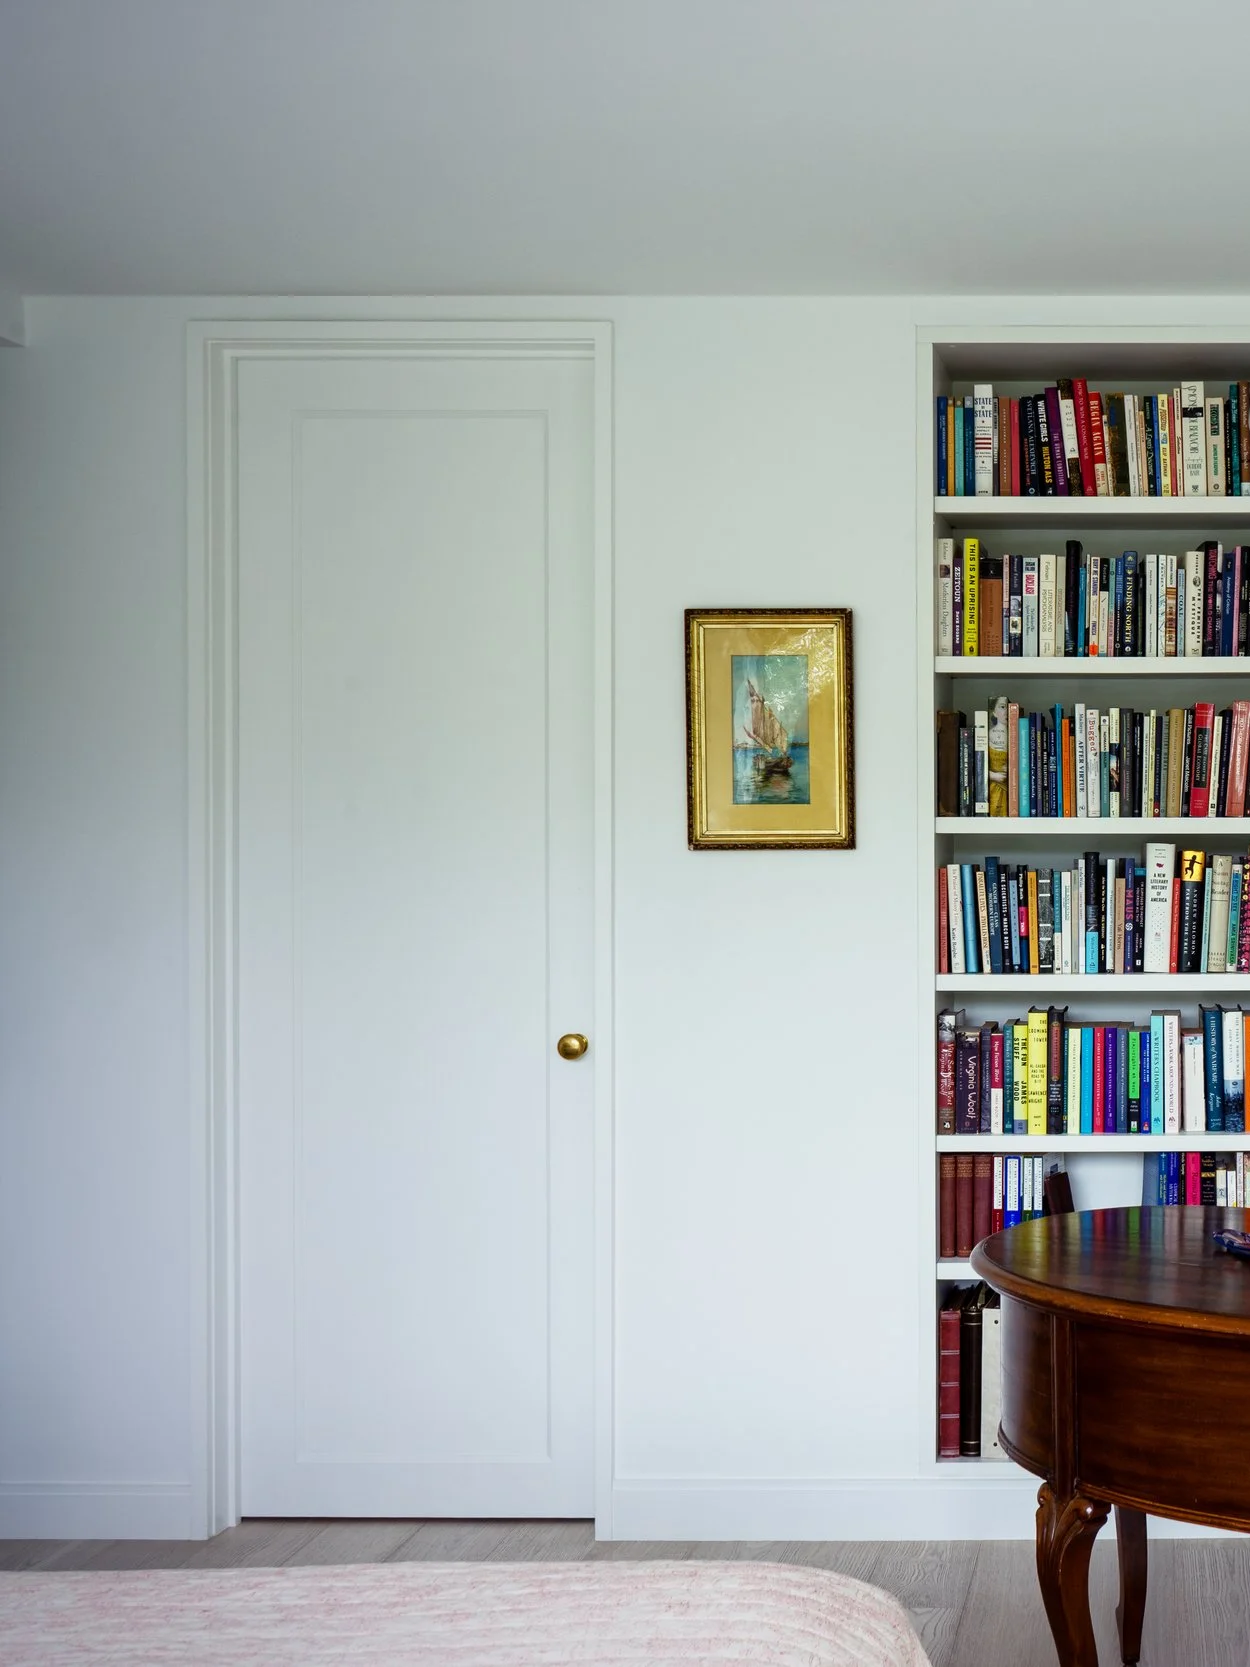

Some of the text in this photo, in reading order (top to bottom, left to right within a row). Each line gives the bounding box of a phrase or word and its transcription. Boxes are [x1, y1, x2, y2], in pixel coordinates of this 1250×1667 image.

[975, 410, 993, 418] STATE
[1089, 400, 1103, 456] BEGIN AGAIN
[1037, 400, 1053, 484] WHITE GIRLS HILTON ALS
[970, 575, 976, 585] AN
[1208, 549, 1217, 579] WATCHING
[965, 1056, 977, 1119] Virginia Woolf
